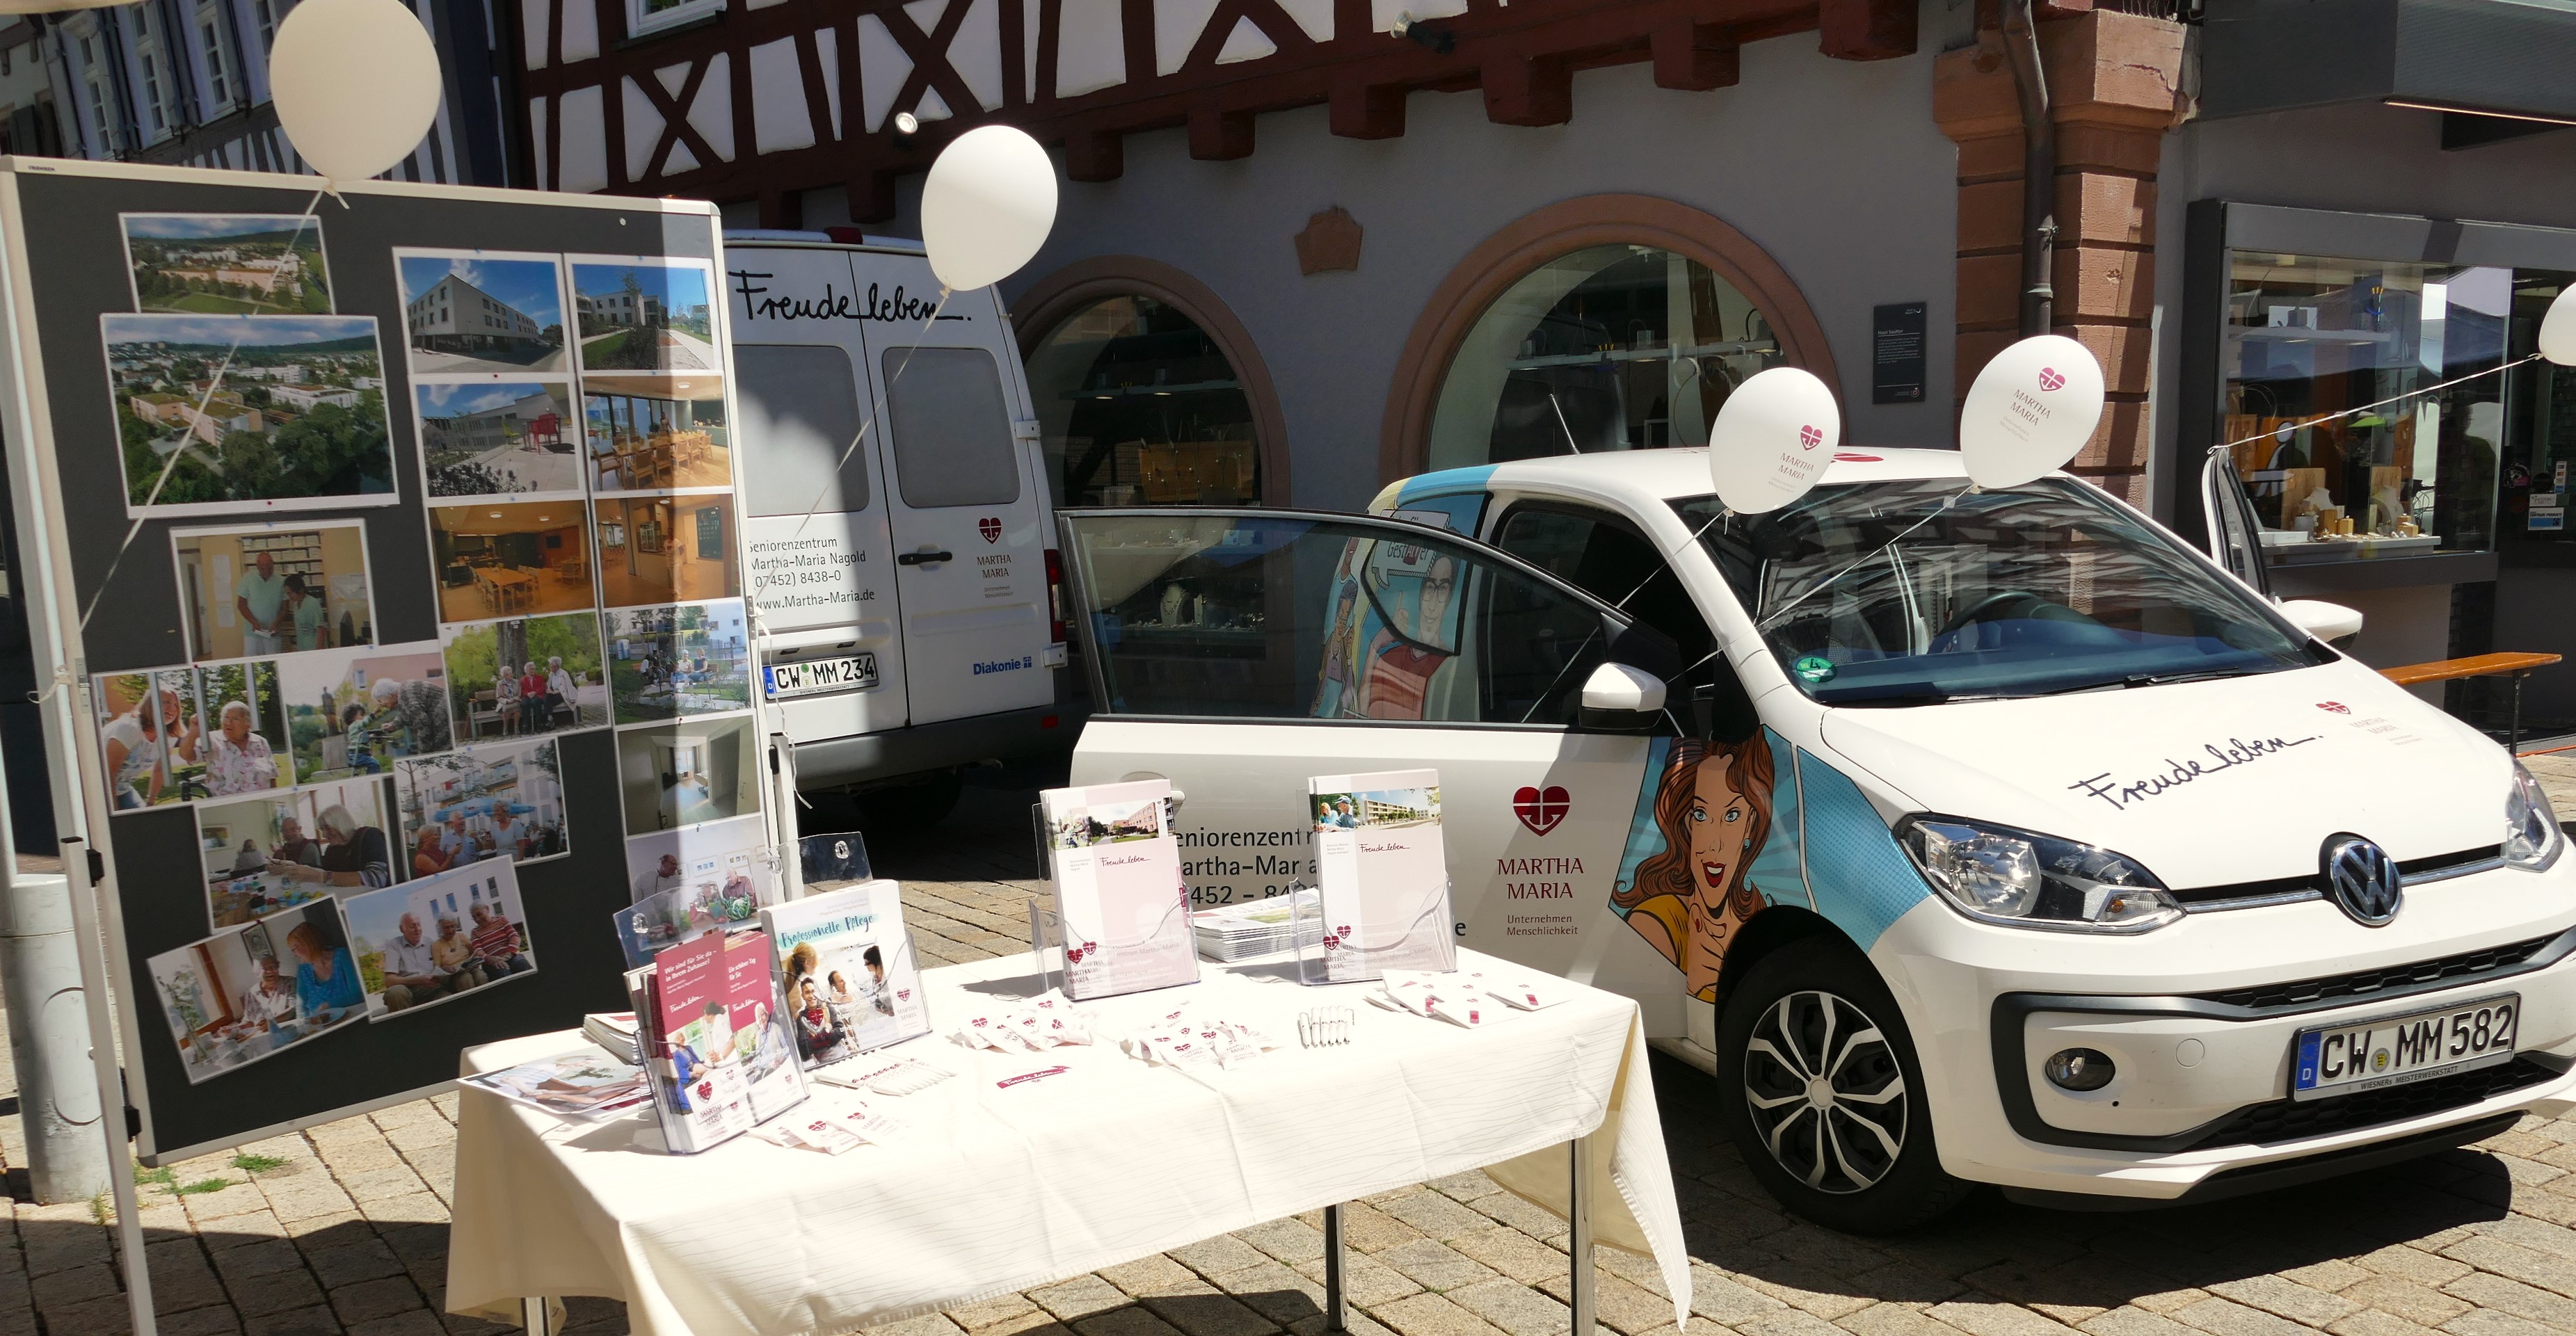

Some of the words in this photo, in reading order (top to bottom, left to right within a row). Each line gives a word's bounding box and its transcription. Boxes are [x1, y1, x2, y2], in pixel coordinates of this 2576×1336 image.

[728, 270, 856, 321] Freude
[2010, 402, 2039, 426] MARIA
[2013, 389, 2051, 419] MARTHA
[1779, 452, 1814, 472] MARTHA
[1777, 465, 1805, 481] MARIA
[751, 554, 826, 570] Martha-Maria
[830, 550, 866, 566] Nagold
[977, 554, 1012, 565] MARTHA
[800, 570, 841, 584] 8438-0
[982, 568, 1009, 579] MARIA
[756, 589, 874, 610] www.Martha-Maria.de
[776, 666, 801, 689] CW
[813, 662, 839, 685] MM
[840, 657, 874, 682] 234
[973, 659, 1021, 675] Diakonie
[2067, 758, 2211, 810] Freude
[2204, 734, 2325, 766] leben.
[1176, 826, 1315, 847] eniorenzentr
[1358, 843, 1386, 853] Freude
[1099, 856, 1125, 867] Freude
[1183, 855, 1318, 876] artha-Mara
[1496, 858, 1584, 875] MARTHA
[1506, 882, 1573, 899] MARIA
[1507, 915, 1572, 924] Unternehmen
[781, 921, 840, 947] Professionelle
[845, 915, 874, 933] Pflege
[1507, 926, 1578, 935] Menschlichkeit
[664, 966, 675, 974] Wir
[675, 960, 686, 970] sind
[687, 957, 695, 965] für
[696, 953, 705, 961] Sie
[671, 968, 687, 979] Ihrem
[687, 958, 710, 973] Zuhause!
[2302, 1068, 2311, 1080] D
[2321, 1029, 2373, 1079] CW
[2394, 1017, 2445, 1067] MM
[2449, 1004, 2513, 1056] 582
[2360, 1079, 2392, 1090] WIESNERs
[2395, 1065, 2458, 1084] MEISTERWERKSTATT
